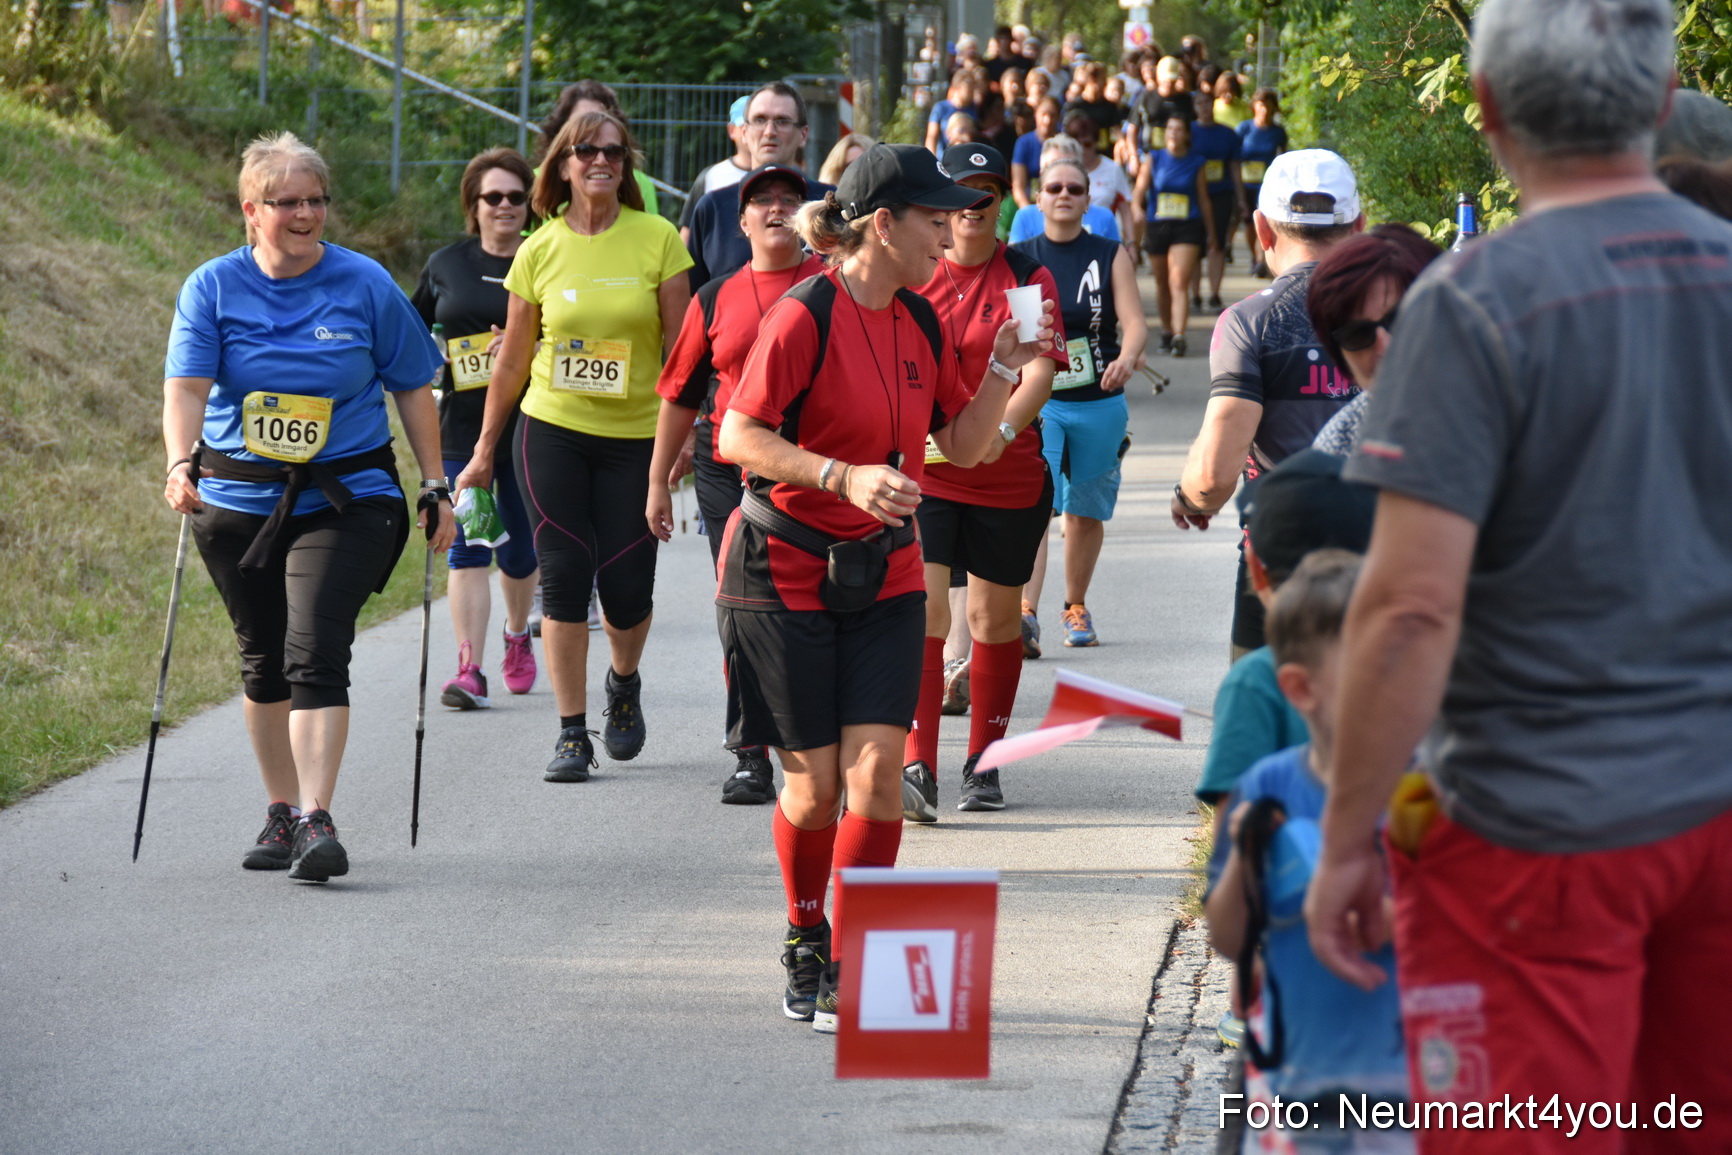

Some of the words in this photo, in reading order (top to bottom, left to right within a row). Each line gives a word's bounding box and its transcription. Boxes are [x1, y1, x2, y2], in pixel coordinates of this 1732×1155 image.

[983, 304, 992, 317] 2
[561, 357, 619, 381] 1296
[903, 360, 919, 380] 10
[253, 416, 319, 445] 1066
